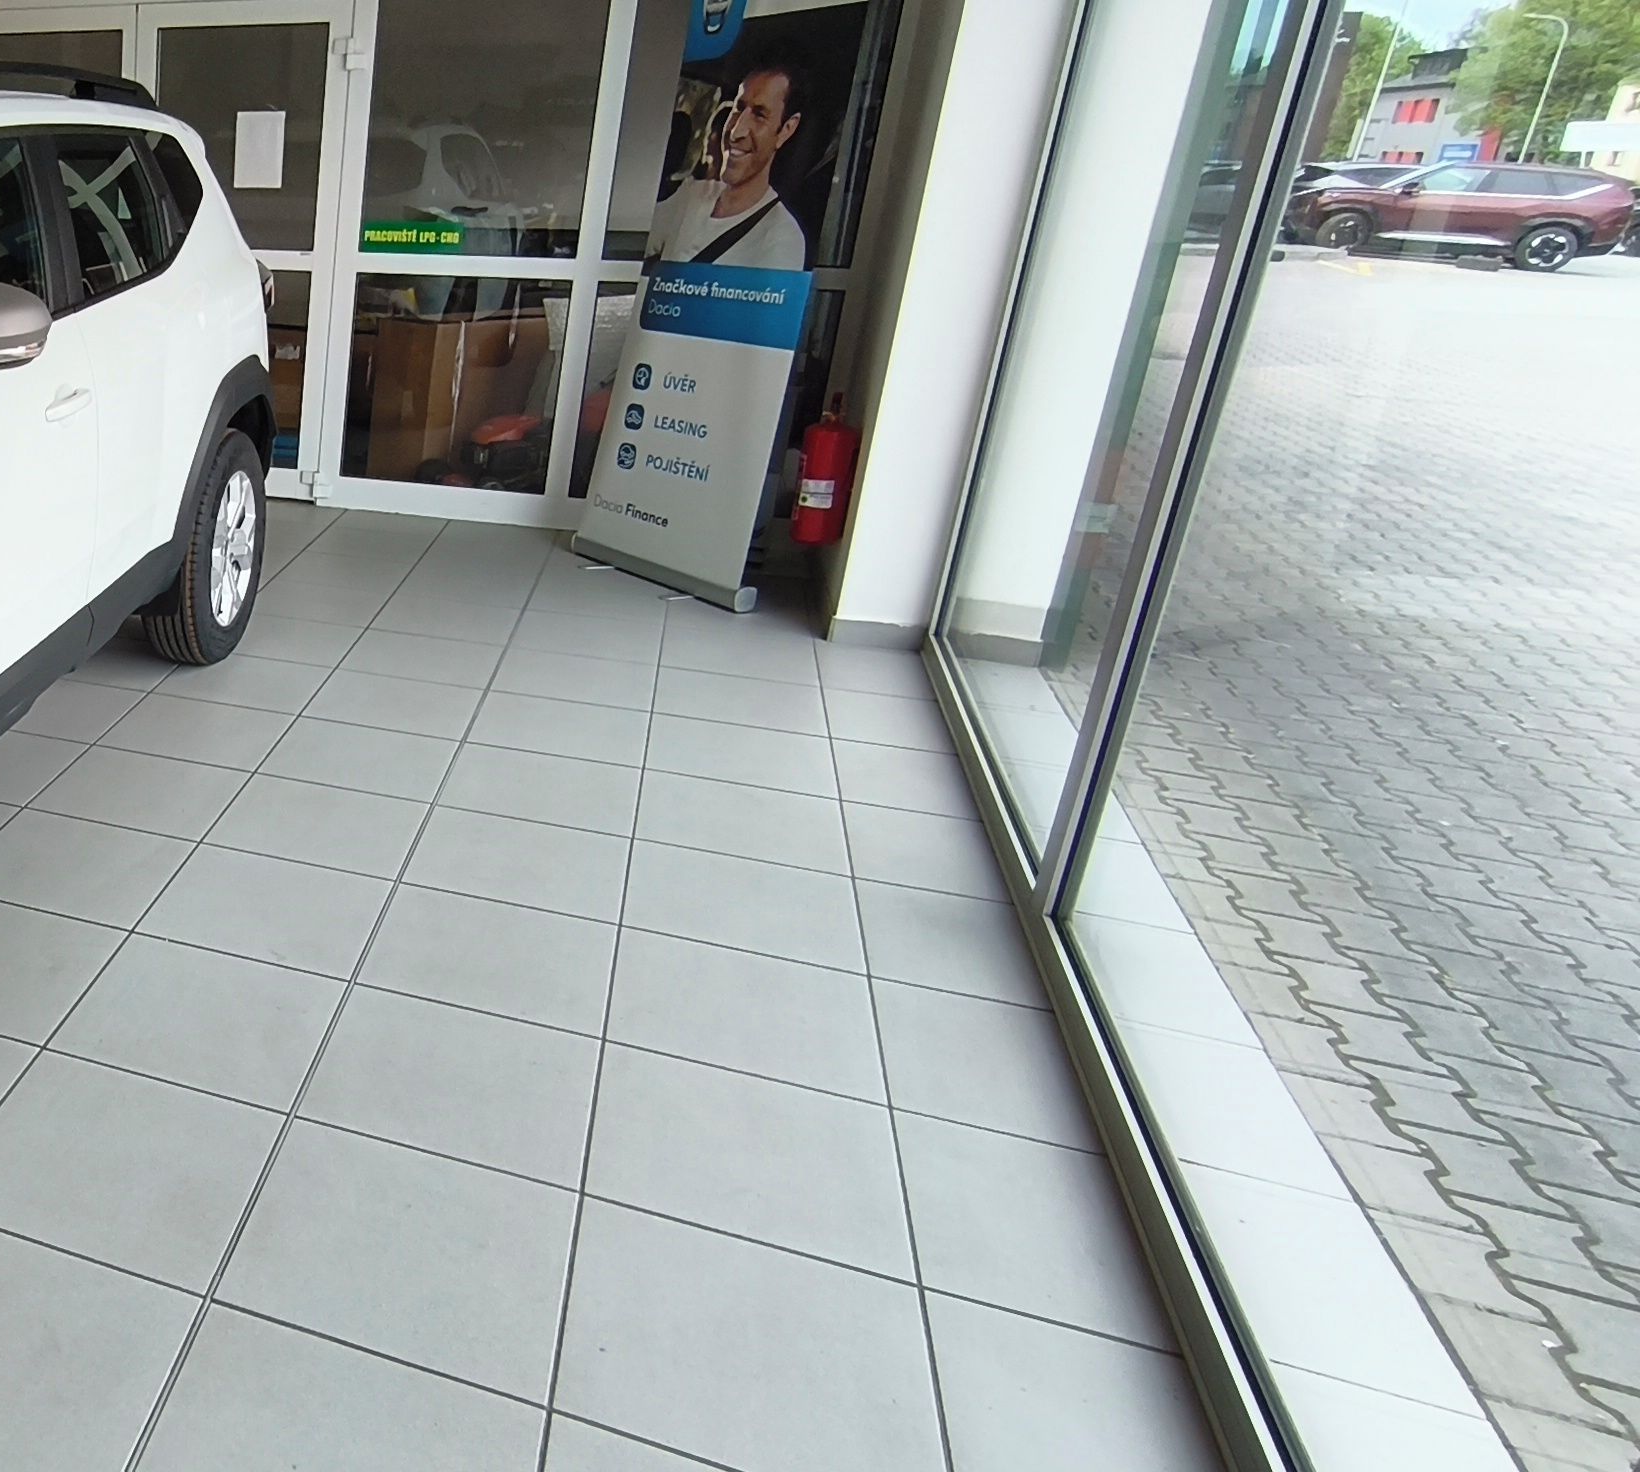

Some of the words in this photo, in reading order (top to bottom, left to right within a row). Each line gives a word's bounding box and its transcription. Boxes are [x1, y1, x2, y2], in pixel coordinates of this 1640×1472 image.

[364, 229, 417, 242] PRACOVIŠTĚ
[653, 277, 708, 296] Značkové
[710, 282, 786, 304] financování
[648, 299, 681, 317] Dacia
[663, 371, 696, 393] ÚVĚR
[654, 415, 708, 439] LEASING
[645, 454, 710, 482] POJIŠTĚNÍ
[593, 494, 624, 514] Dacia
[624, 503, 669, 527] Finance
